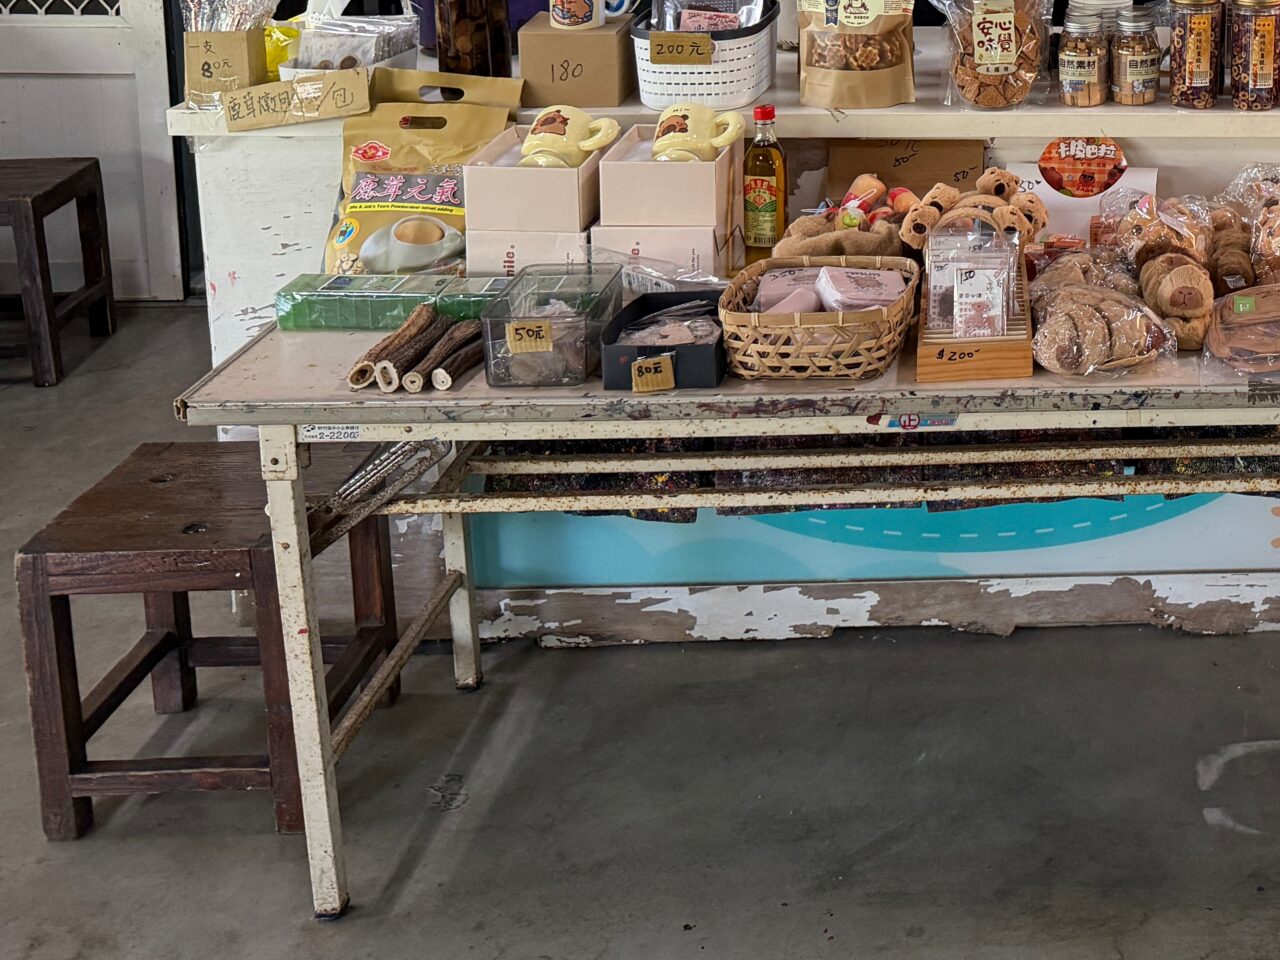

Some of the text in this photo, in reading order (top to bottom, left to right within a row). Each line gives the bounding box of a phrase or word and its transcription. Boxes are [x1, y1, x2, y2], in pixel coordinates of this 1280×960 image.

[977, 17, 1012, 37] 安心
[656, 42, 705, 56] 200元
[551, 59, 584, 82] 180
[1058, 139, 1117, 159] 卡皮巴拉
[350, 173, 461, 205] 鹿茸元氣
[514, 326, 545, 341] 50元
[636, 362, 663, 377] 80元
